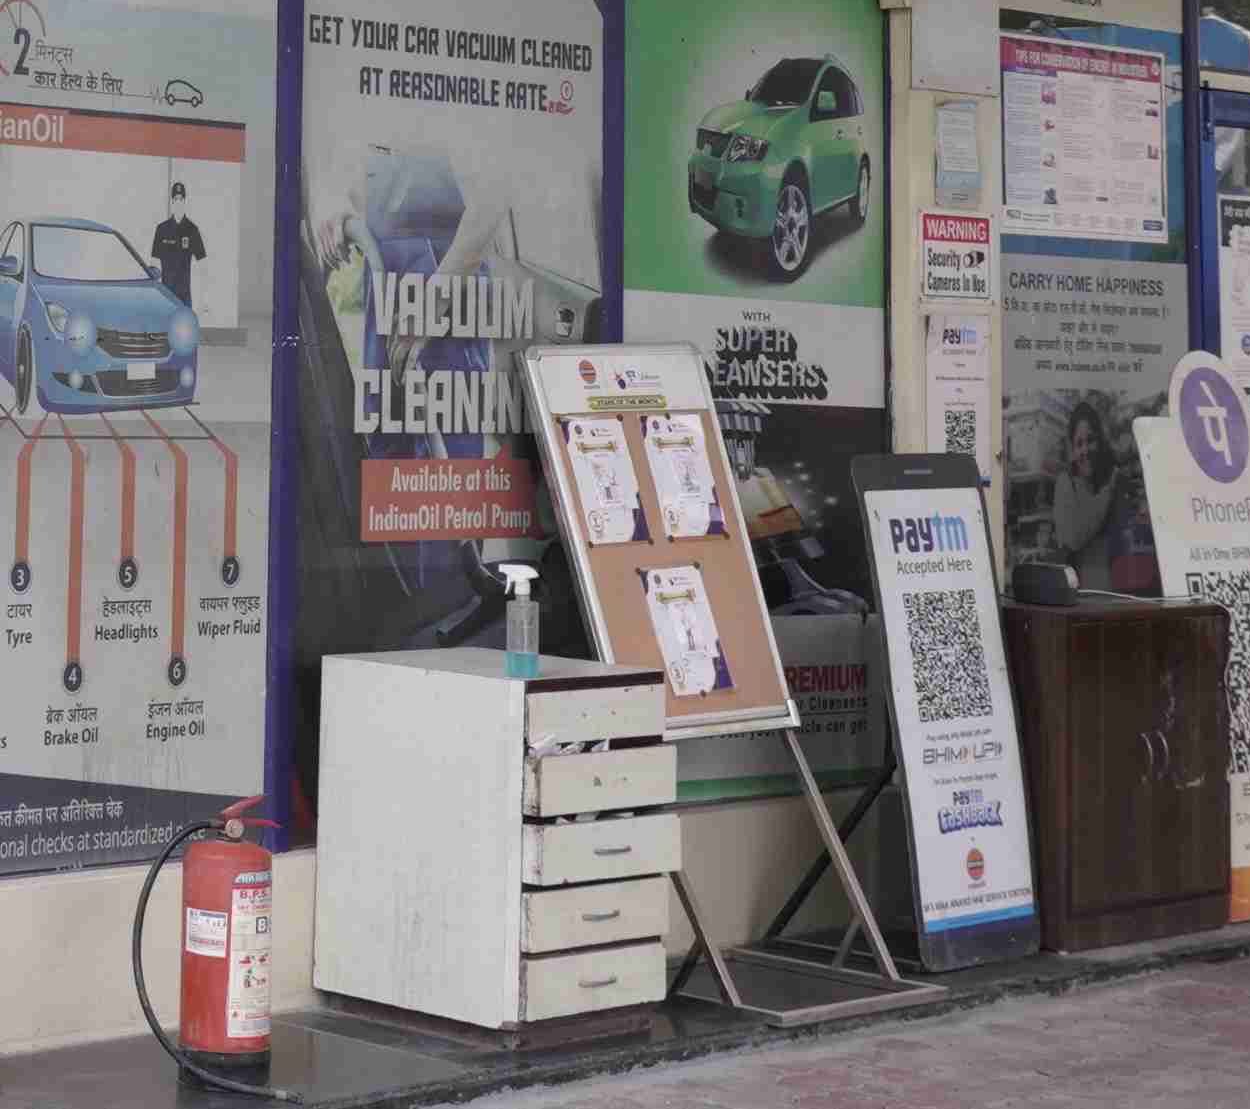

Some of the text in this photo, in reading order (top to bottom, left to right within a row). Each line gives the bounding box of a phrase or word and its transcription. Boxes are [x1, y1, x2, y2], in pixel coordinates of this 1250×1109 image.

[13, 28, 31, 76] 2
[309, 14, 593, 72] GET YOUR CAR VACUUM CLEANED
[359, 66, 383, 95] AT
[389, 70, 500, 107] REASONABLE
[926, 218, 987, 242] WARNING
[927, 247, 961, 271] Security
[927, 271, 961, 292] Cameras
[971, 271, 986, 293] Use
[1009, 272, 1165, 296] CARRY HOME HAPPINESS
[372, 271, 534, 339] VACUUM
[743, 310, 771, 323] WITH
[714, 328, 796, 358] SUPER
[711, 358, 828, 397] EANSERS
[354, 368, 536, 435] CLEANIN
[391, 466, 512, 492] Available at this
[369, 505, 532, 533] IndianOil Petrol Pump
[897, 557, 974, 577] Accepted Here
[6, 628, 33, 645] Tyre
[95, 625, 158, 642] Headlights
[197, 617, 261, 638] Wiper Fluid
[44, 726, 99, 746] Brake Oil
[146, 720, 205, 742] Engine Oil
[31, 821, 173, 856] checks at standardized
